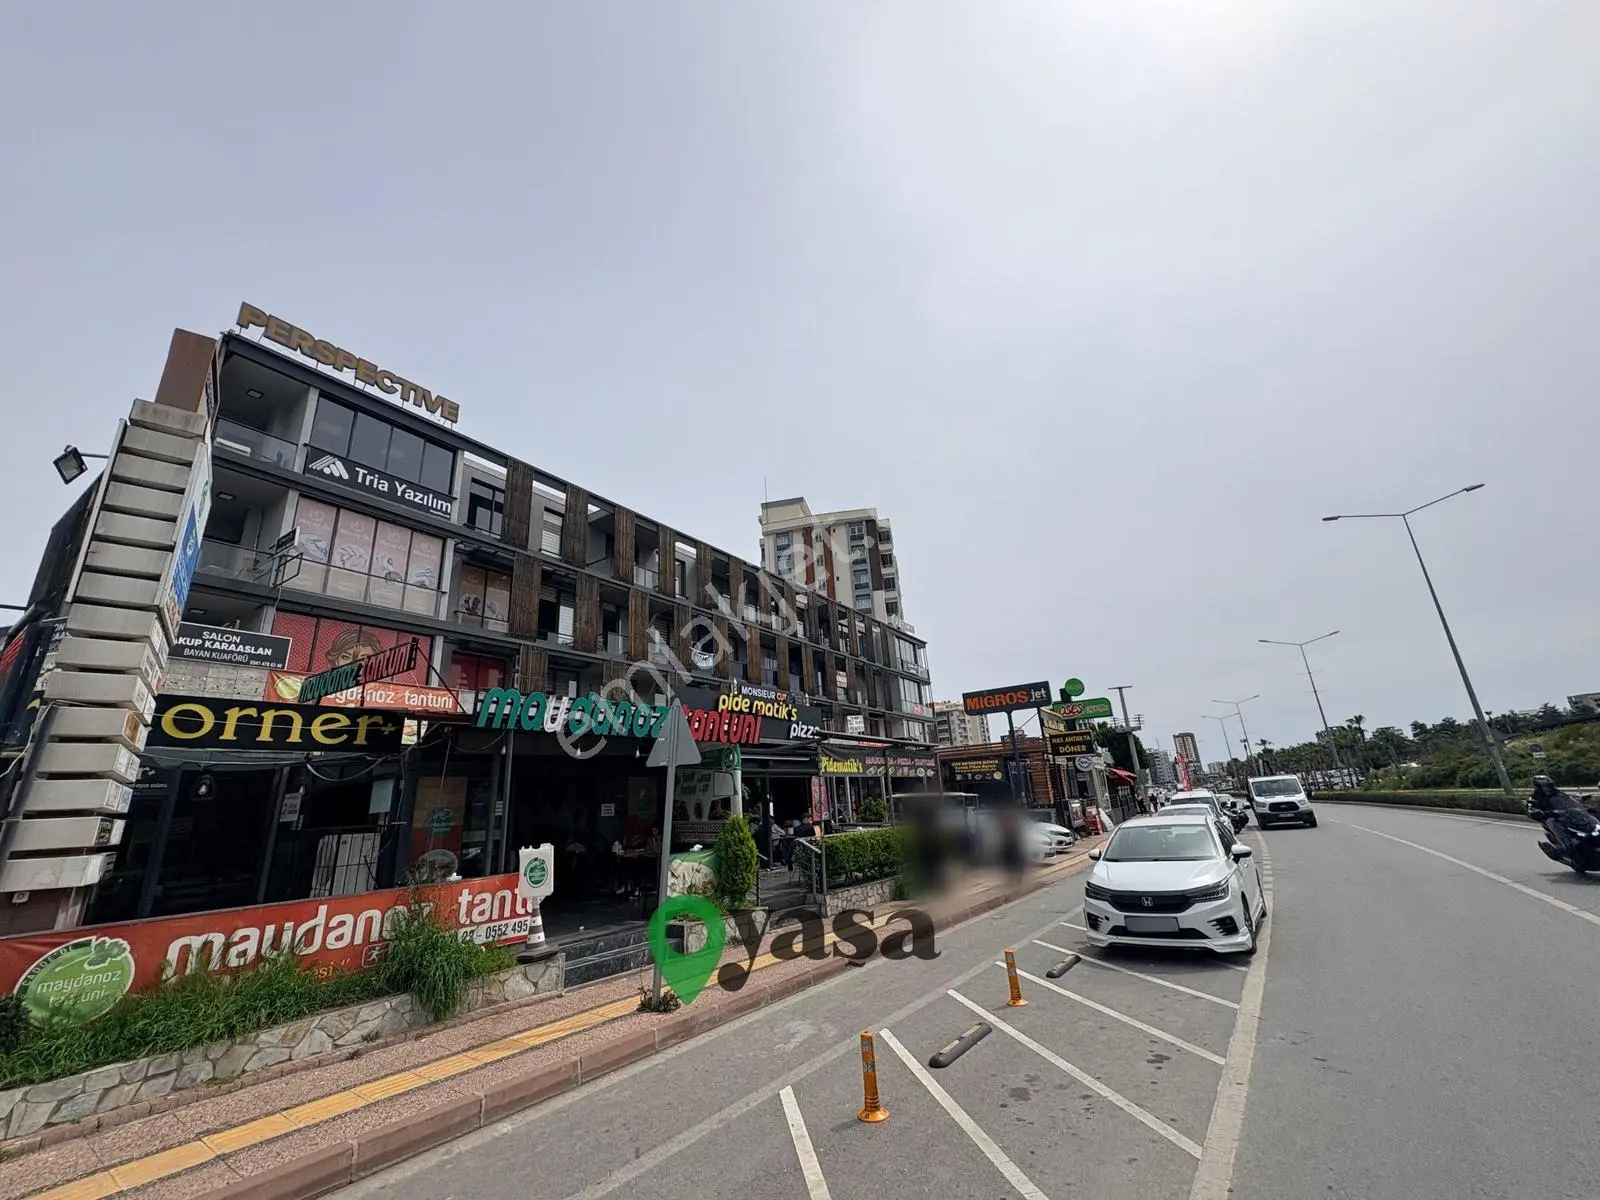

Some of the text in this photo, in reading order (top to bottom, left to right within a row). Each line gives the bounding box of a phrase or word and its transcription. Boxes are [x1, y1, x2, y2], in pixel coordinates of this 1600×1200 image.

[236, 301, 460, 424] PERSPECTIVE
[355, 467, 389, 493] Tria
[176, 636, 272, 656] KUP KARAASLAN
[202, 631, 241, 643] SALON
[183, 648, 210, 658] BAYAN
[741, 685, 776, 700] MONSIEUR
[1029, 687, 1048, 702] jet
[718, 694, 798, 721] pide matik's
[1059, 745, 1087, 753] DÖNER
[485, 923, 509, 940] 0552
[511, 919, 529, 935] 495
[36, 970, 122, 994] maydanoz
